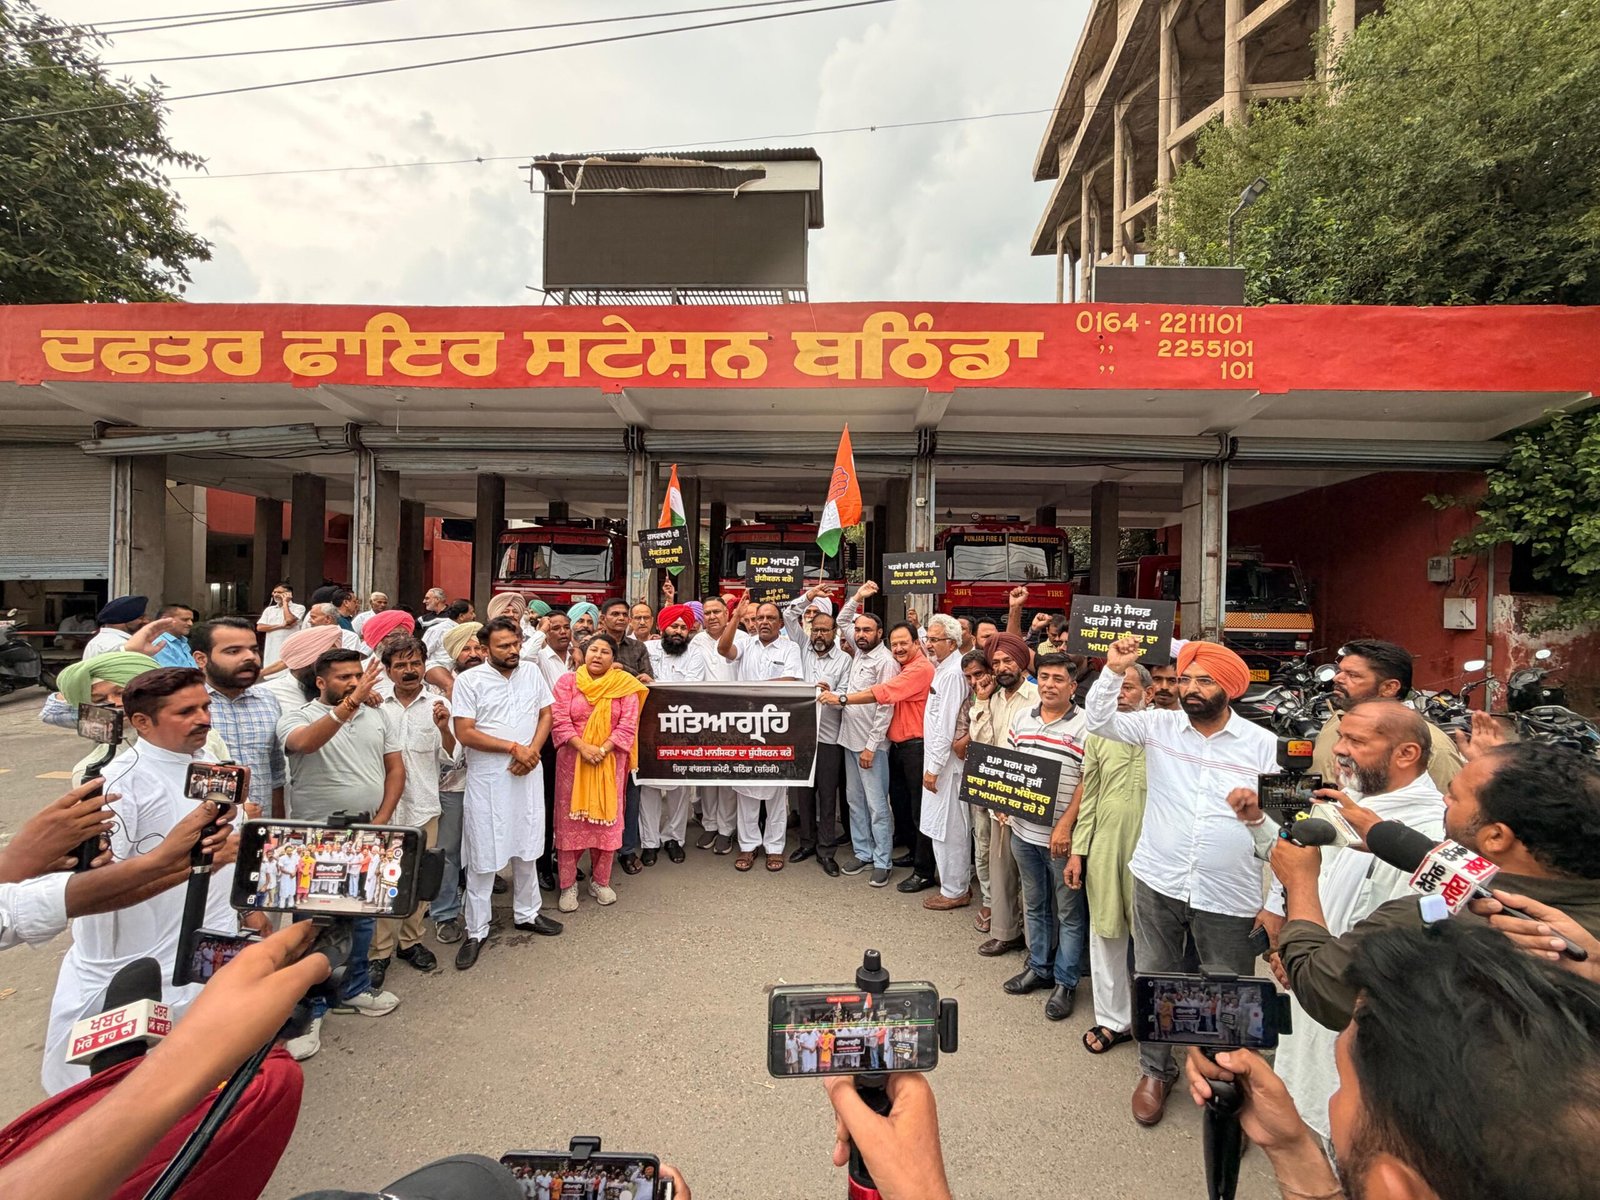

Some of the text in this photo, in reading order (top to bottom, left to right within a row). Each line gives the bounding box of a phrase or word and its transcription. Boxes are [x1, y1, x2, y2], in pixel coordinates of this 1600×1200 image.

[1076, 310, 1139, 333] 0164
[1159, 312, 1243, 334] 2211101
[282, 312, 505, 377] ਫਾਇਰ
[523, 314, 769, 379] ਸਟੇਸ਼ਨ
[791, 311, 1045, 380] ਬਠਿੰਡਾ
[1157, 339, 1254, 358] 2255101
[1220, 361, 1254, 380] 101
[985, 535, 998, 543] FIRE
[1009, 536, 1059, 544] EMERGENCY SERVICES
[750, 555, 799, 566] BJP ਆਪਣੀ
[1047, 590, 1064, 598] FIRE
[1093, 604, 1111, 613] BJP
[1113, 603, 1122, 614] ਨੇ
[1084, 614, 1158, 630] ਖੜਗੇ ਜੀ ਦਾ ਨਹੀਂ
[1100, 631, 1115, 640] ਹਰ
[1146, 635, 1158, 644] ਦਾ
[658, 704, 791, 744] ਸੱਤਿਆਗ੍ਰਹਿ
[680, 747, 702, 756] ਆਪਣੀ
[704, 747, 737, 756] ਮਾਨਸਿਕਤਾ
[779, 747, 791, 756] ਕਰੇ
[986, 755, 1002, 765] BJP
[967, 775, 986, 786] ਬਾਬਾ
[987, 780, 1013, 794] ਸਾਹਿਬ
[1006, 770, 1025, 784] ਕਰਕੇ
[968, 787, 977, 796] ਦਾ
[979, 790, 1006, 804] ਅਪਮਾਨ
[1008, 798, 1021, 808] ਕਰ
[1023, 802, 1036, 813] ਰਹੇ
[1416, 861, 1447, 893] दैनिक
[1440, 873, 1471, 907] सवेरा
